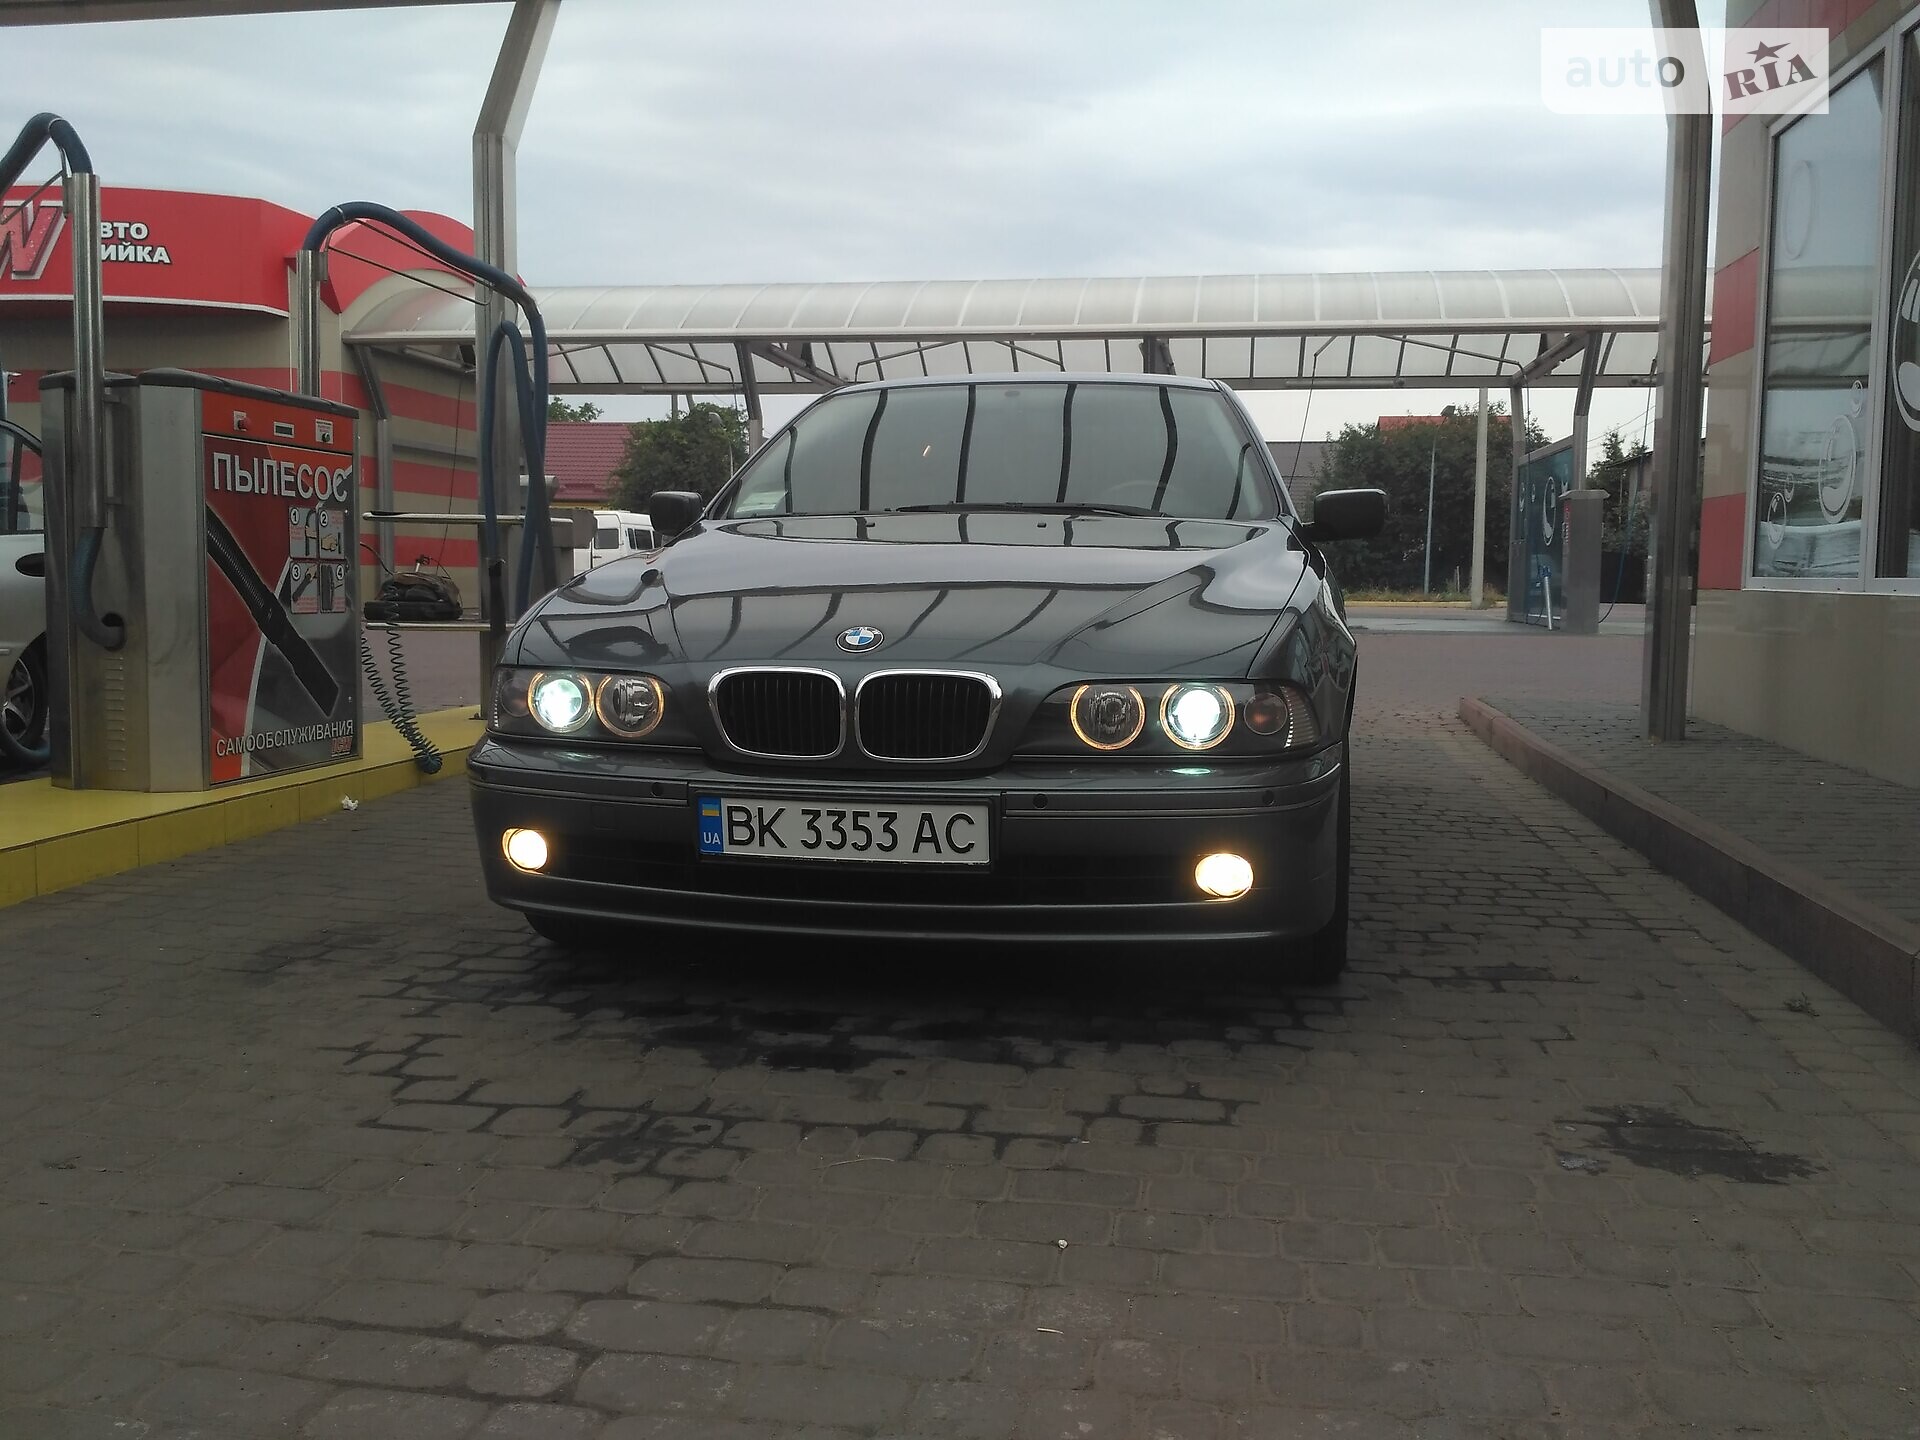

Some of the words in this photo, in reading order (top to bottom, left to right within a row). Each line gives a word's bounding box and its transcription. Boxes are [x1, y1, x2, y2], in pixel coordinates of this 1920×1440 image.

[100, 222, 149, 240] ВТО
[101, 241, 171, 264] ИЙКА
[213, 452, 348, 502] ПЫЛЕСОС
[216, 719, 354, 756] САМООБСЛУЖИВАНИЯ
[703, 832, 721, 845] UA
[727, 805, 787, 848] BK
[800, 808, 898, 852] 3353
[912, 812, 975, 854] AC
